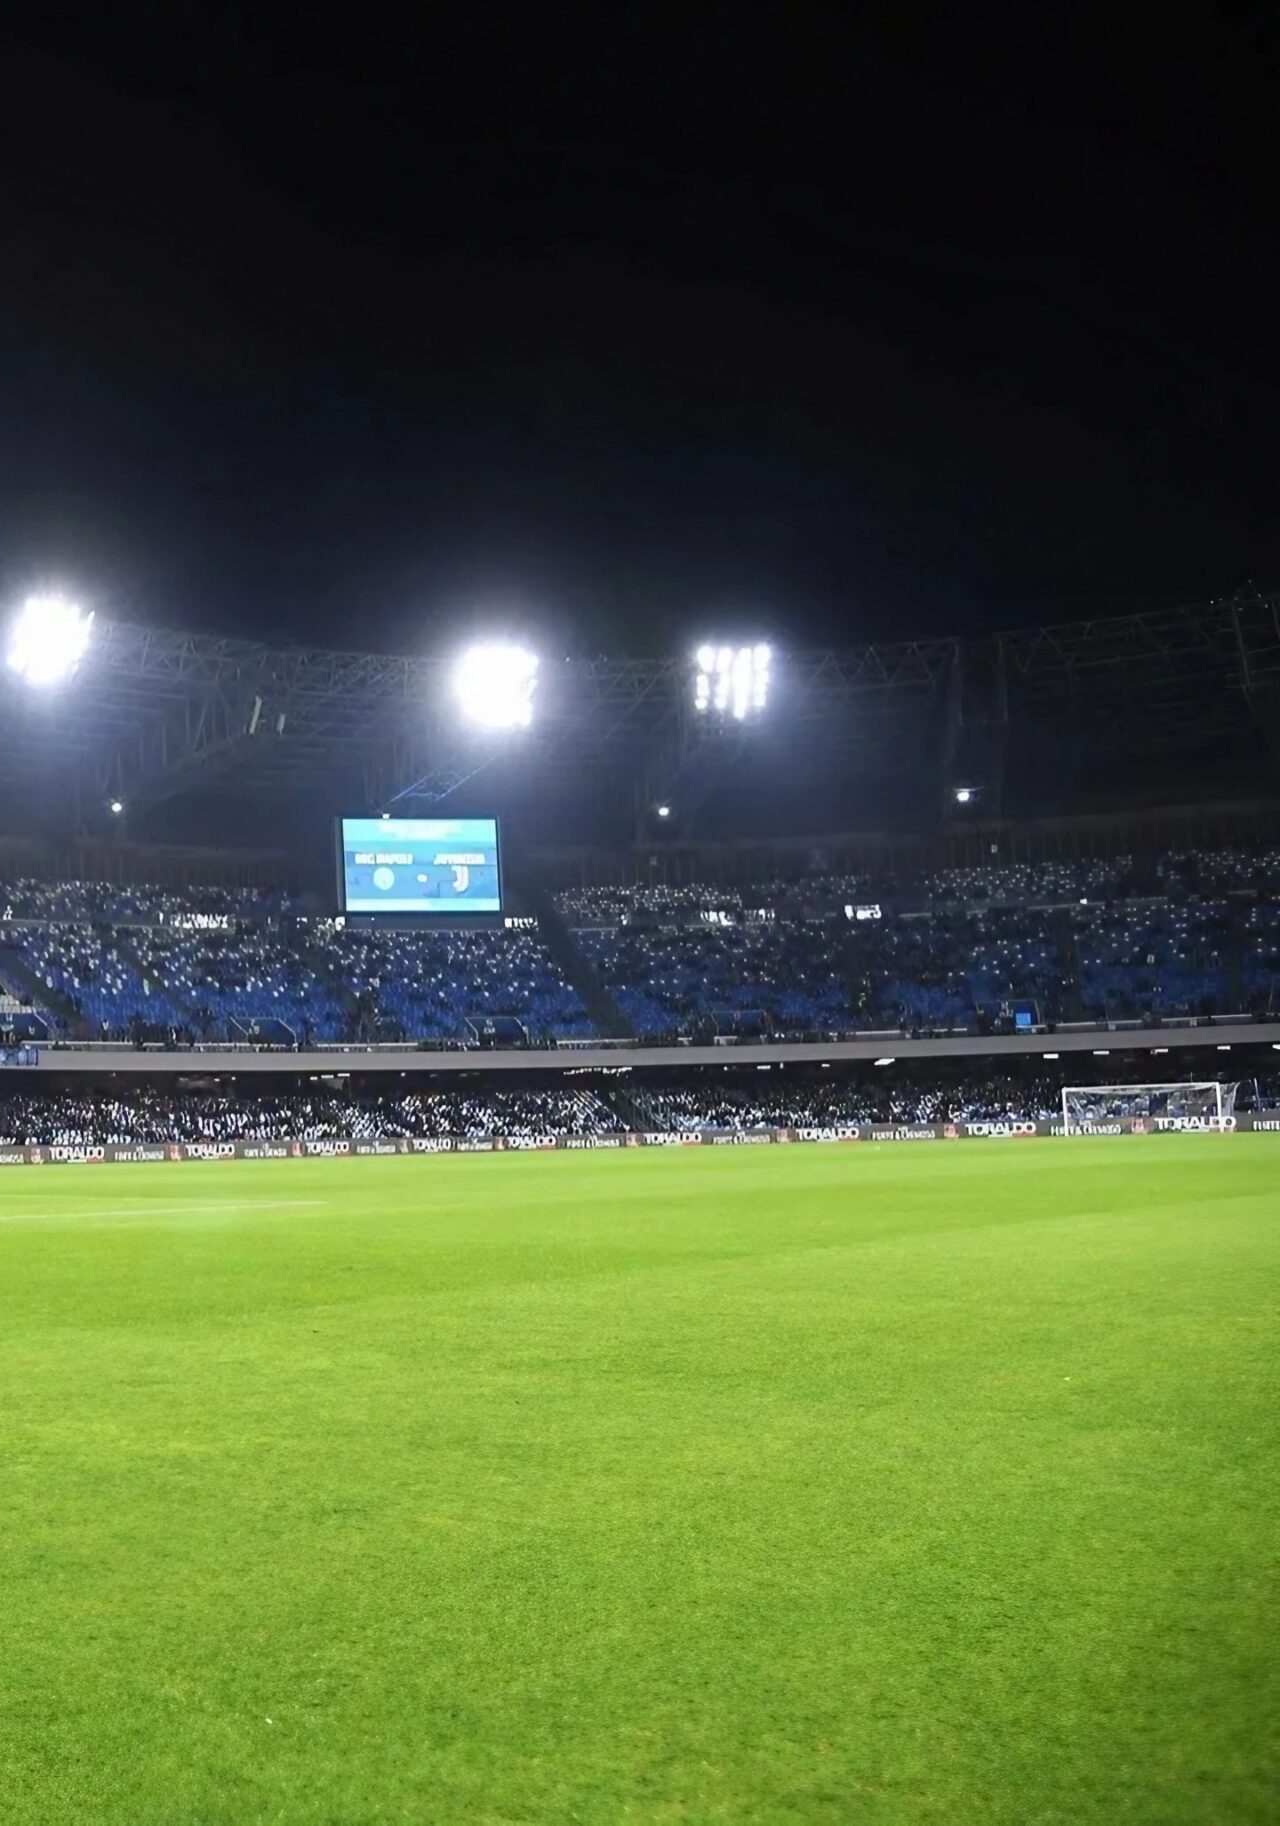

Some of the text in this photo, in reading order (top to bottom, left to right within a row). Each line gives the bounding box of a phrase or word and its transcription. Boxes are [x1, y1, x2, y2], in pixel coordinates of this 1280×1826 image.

[965, 1121, 1037, 1135] TORALDO
[1154, 1116, 1237, 1130] TORALDO
[48, 1146, 105, 1160] TORALDO
